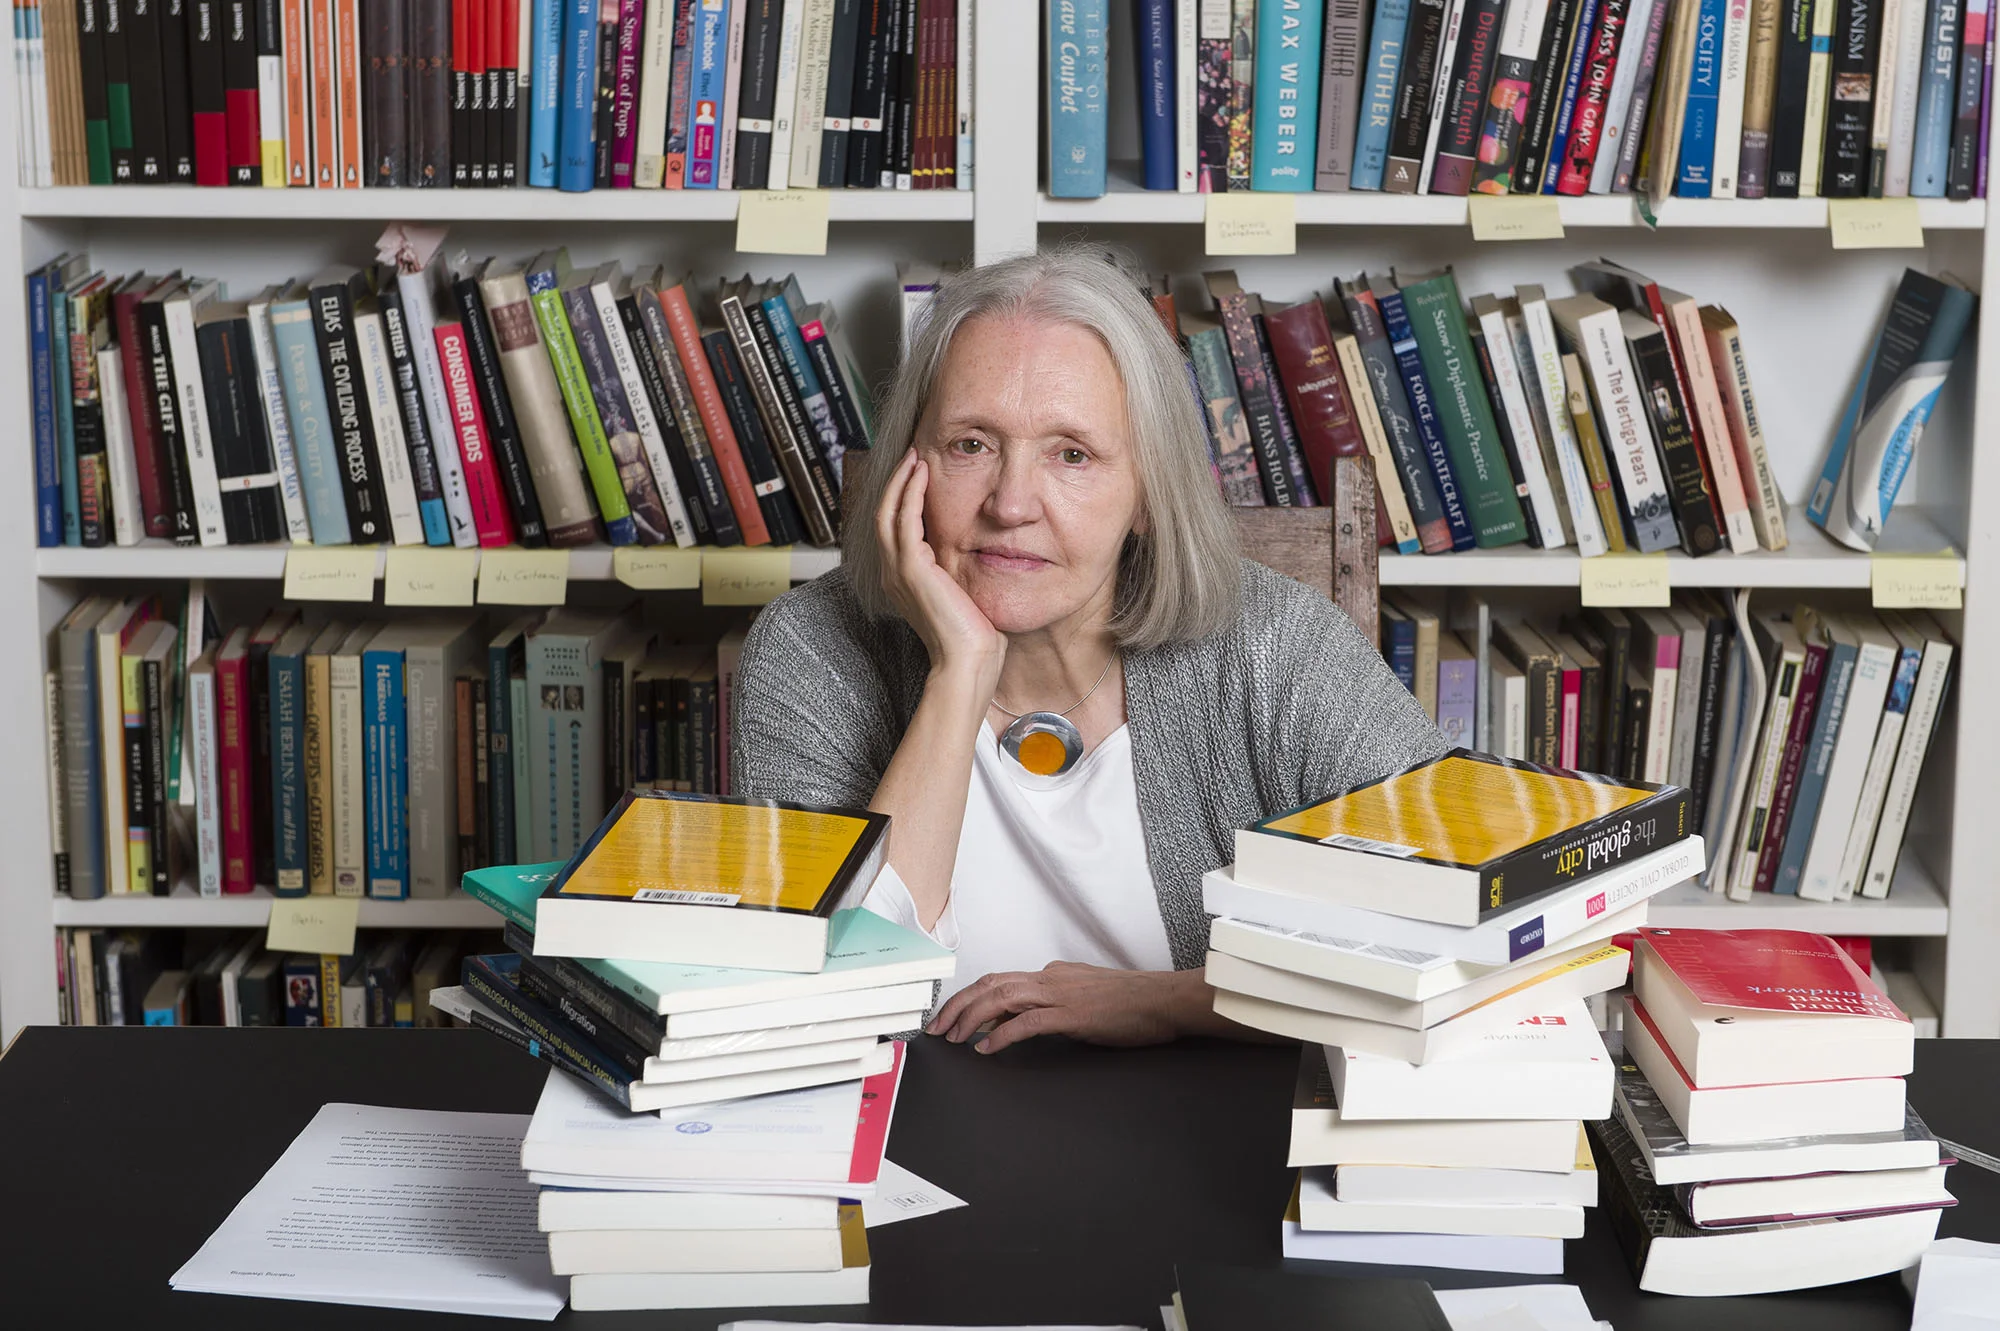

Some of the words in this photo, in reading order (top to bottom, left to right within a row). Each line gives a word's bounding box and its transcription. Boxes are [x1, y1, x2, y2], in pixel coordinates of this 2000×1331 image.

[620, 15, 638, 51] Stage
[701, 13, 717, 70] Facebook
[806, 17, 820, 59] Modern
[817, 13, 832, 55] Printing
[1149, 4, 1163, 50] SILENCE
[1279, 0, 1301, 49] MAX
[1425, 14, 1438, 30] My
[1597, 14, 1618, 57] MASS
[577, 29, 589, 68] Richard
[619, 54, 636, 80] Life
[1153, 57, 1163, 78] Sara
[1330, 24, 1358, 78] LUTHER
[1415, 33, 1435, 80] Struggle
[1463, 10, 1495, 95] Disputed
[1641, 31, 1659, 67] BLACK
[1694, 13, 1717, 86] SOCIETY
[454, 72, 465, 109] Sennett
[470, 72, 481, 109] Sennett
[486, 72, 497, 109] Sennett
[504, 71, 514, 108] Sennett
[547, 54, 557, 108] TOGETHER
[575, 71, 587, 108] Sennett
[619, 83, 634, 98] of
[700, 72, 711, 97] Effect
[801, 64, 815, 101] Europe
[812, 58, 828, 118] Revolution
[1057, 41, 1082, 113] Courbet
[1369, 39, 1399, 129] LUTHER
[1416, 81, 1428, 98] for
[1586, 63, 1607, 104] JOHN
[1085, 84, 1101, 113] OF
[1153, 78, 1165, 117] Maitland
[1274, 61, 1300, 155] WEBER
[1400, 84, 1413, 119] Memoirs
[1449, 78, 1465, 116] Memoirs
[614, 100, 632, 138] Props
[811, 121, 821, 132] in
[1406, 100, 1425, 146] Freedom
[1454, 98, 1478, 147] Truth
[1576, 106, 1597, 148] GRAY
[1623, 132, 1637, 161] LEADER
[1271, 166, 1299, 178] polity
[319, 295, 343, 334] ELIAS
[385, 307, 408, 359] CASTELLS
[645, 305, 667, 345] Children
[749, 308, 761, 324] THE
[754, 322, 770, 344] ERICK
[1431, 307, 1457, 357] Satow's
[328, 337, 348, 363] THE
[366, 323, 381, 362] GEORG
[670, 301, 685, 323] THE
[678, 324, 702, 372] TRIUMPH
[695, 372, 707, 387] OF
[763, 342, 782, 374] HAWKINS
[1728, 336, 1741, 354] THE
[37, 349, 49, 411] TROUBLING
[151, 354, 170, 392] THE
[396, 362, 416, 391] The
[599, 304, 635, 376] Consumer
[623, 379, 656, 441] Society
[634, 327, 660, 381] SENSATIONAL
[652, 380, 676, 428] KNOWLEDGE
[660, 348, 688, 410] Consumption,
[775, 374, 793, 403] MODERN
[813, 342, 838, 391] Performance
[831, 389, 841, 397] Art
[1297, 376, 1337, 394] talleyrand
[1606, 368, 1627, 395] The
[157, 391, 177, 435] GIFT
[331, 363, 360, 430] CIVILIZING
[442, 334, 476, 423] CONSUMER
[461, 423, 484, 463] KIDS
[787, 402, 802, 425] DANCE
[1407, 373, 1434, 423] FORCE
[1442, 357, 1478, 431] Diplomatic
[401, 390, 426, 445] Internet
[679, 408, 705, 462] Advertising,
[1253, 413, 1279, 459] HANS
[1423, 423, 1436, 441] and
[1608, 394, 1642, 447] Vertigo
[1667, 423, 1683, 437] the
[39, 414, 52, 488] CONFESSIONS
[342, 429, 368, 484] PROCESS
[795, 424, 816, 461] TECHNIQUE
[1466, 430, 1493, 482] Practice
[1663, 435, 1694, 451] Books
[410, 445, 436, 493] Galaxy
[698, 461, 710, 478] and
[1426, 439, 1469, 529] STATECRAFT
[1626, 446, 1652, 486] Years
[71, 457, 104, 524] SENNETT
[284, 472, 300, 500] MAN
[703, 478, 720, 507] Media
[1482, 521, 1516, 536] OXFORD
[278, 670, 293, 722] ISAIAH
[377, 664, 389, 722] HABERMAS
[1544, 670, 1558, 707] Letters
[1544, 708, 1558, 735] from
[279, 726, 295, 782] BERLIN:
[304, 712, 322, 779] CONCEPTS
[308, 795, 325, 879] CATEGORIES
[1590, 831, 1606, 841] YORK
[1606, 824, 1619, 834] NEW
[1634, 818, 1657, 846] the
[1677, 801, 1686, 836] Sassen
[1542, 848, 1562, 860] TOKYO
[1555, 846, 1584, 877] city
[1565, 837, 1589, 850] LONDON
[1587, 820, 1632, 871] global
[1587, 895, 1606, 915] 2001
[1520, 927, 1543, 945] OXFORD
[1746, 985, 1879, 1001] Handwerk
[1785, 994, 1890, 1010] Sennett
[1791, 1002, 1898, 1019] Richard
[467, 972, 518, 1014] TECHNOLOGICAL
[511, 1003, 549, 1040] REVOLUTIONS
[548, 1032, 563, 1051] AND
[562, 1039, 594, 1071] FINANCIAL
[591, 1063, 617, 1090] CAPITAL
[559, 997, 598, 1036] Migration
